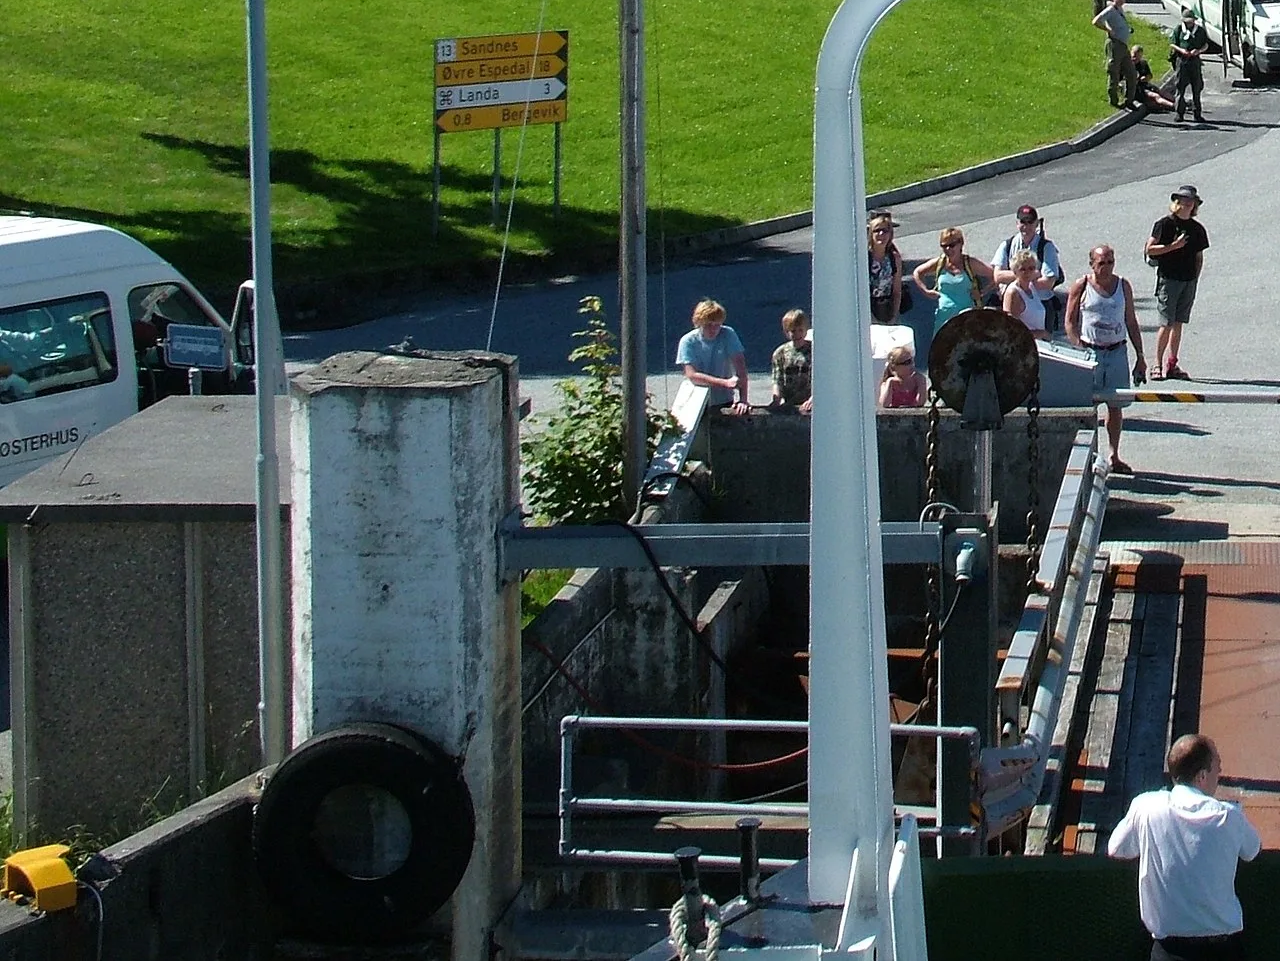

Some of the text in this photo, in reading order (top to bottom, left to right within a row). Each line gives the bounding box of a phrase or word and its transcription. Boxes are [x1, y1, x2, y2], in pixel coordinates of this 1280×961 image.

[441, 40, 519, 57] 13 Sandnes
[442, 60, 550, 81] Øvre Espedal 18
[459, 83, 551, 102] Landa 3
